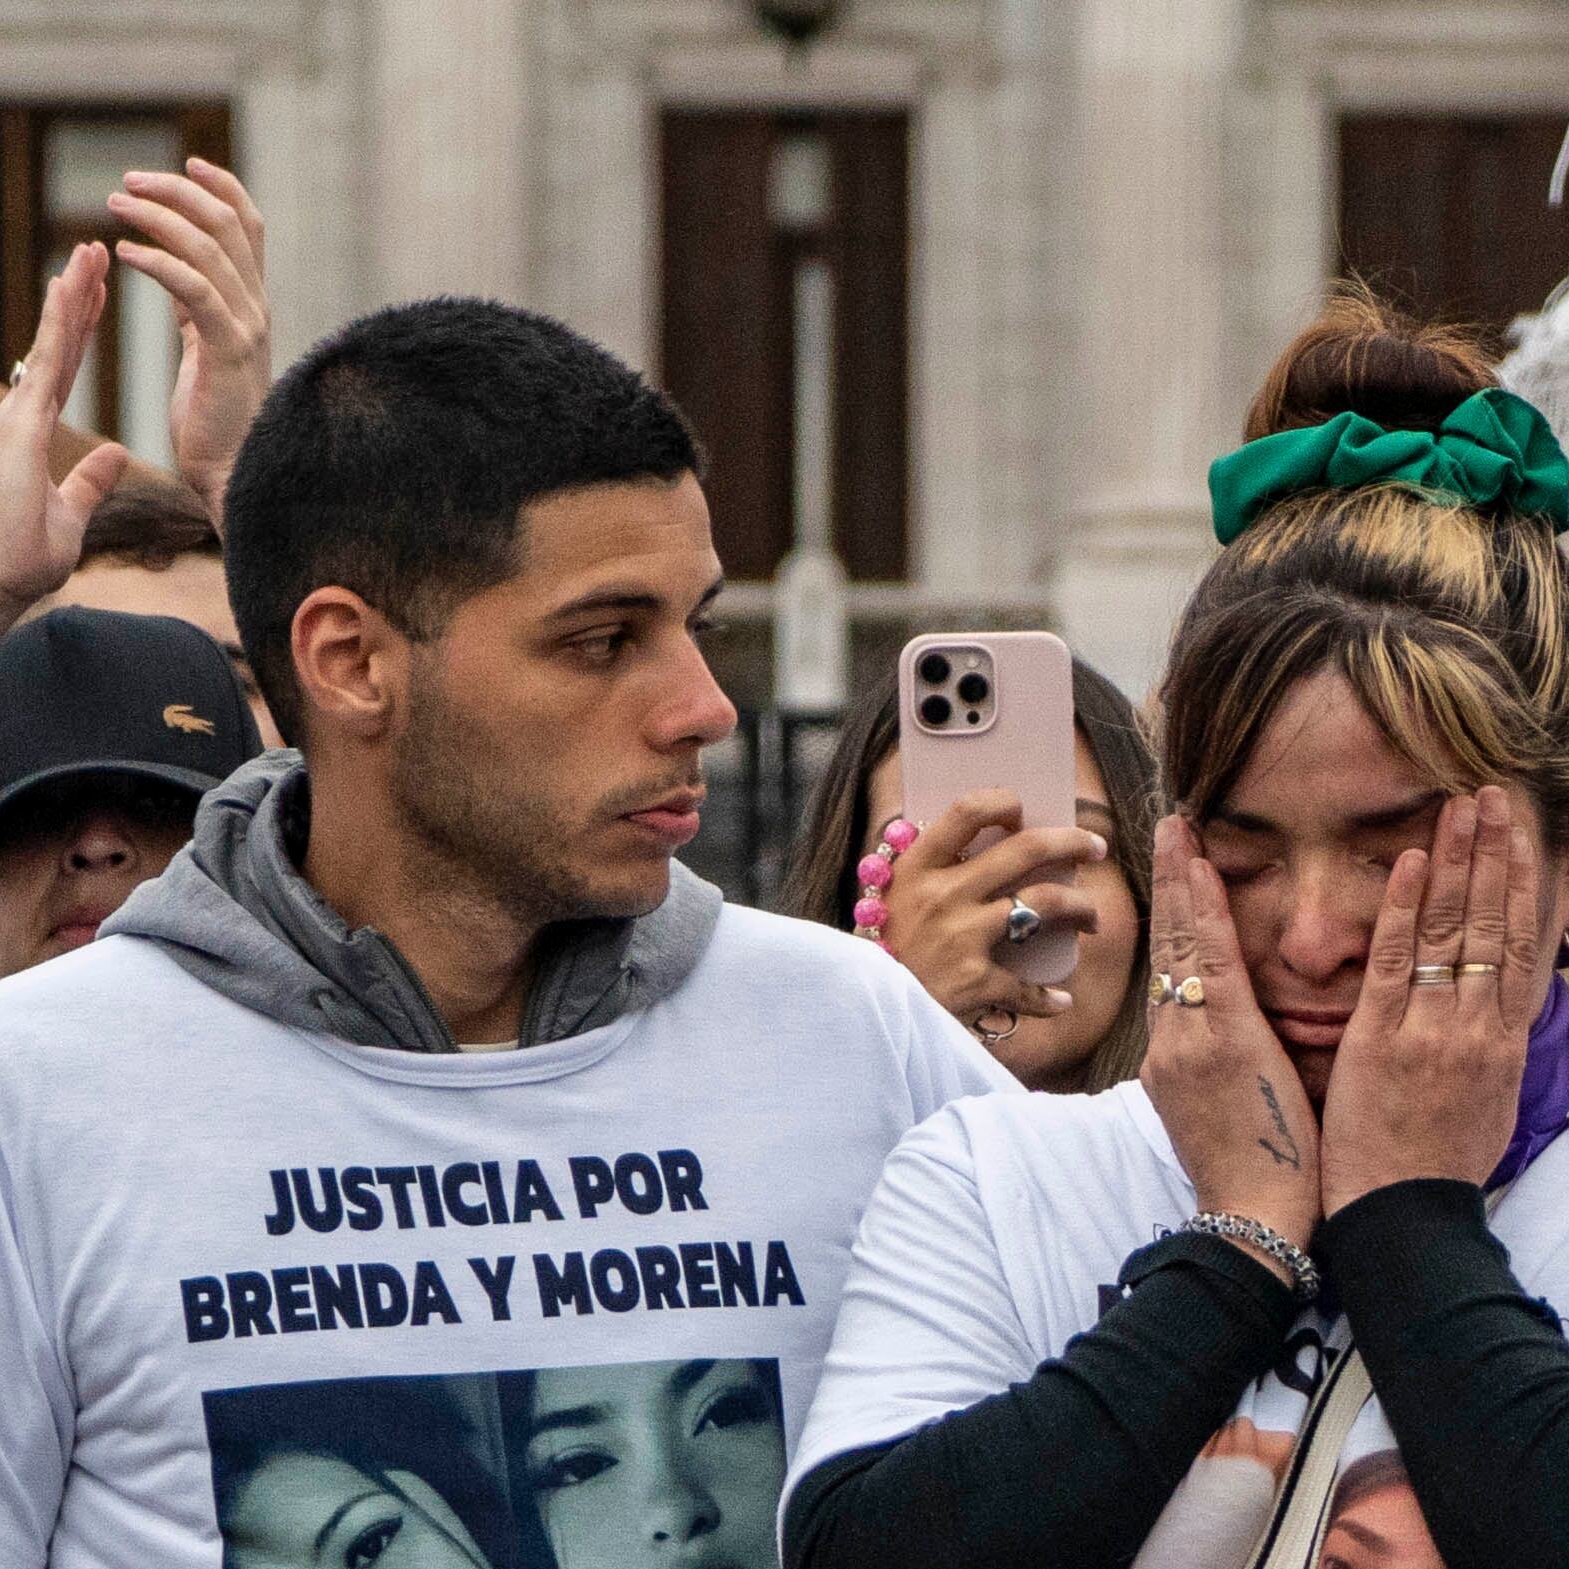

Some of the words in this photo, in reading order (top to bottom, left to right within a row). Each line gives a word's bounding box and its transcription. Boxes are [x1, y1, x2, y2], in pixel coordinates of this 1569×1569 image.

[264, 1158, 562, 1236] JUSTICIA
[567, 1148, 709, 1218] POR
[179, 1259, 462, 1343] BRENDA
[467, 1253, 518, 1323] Y
[532, 1239, 807, 1319] MORENA
